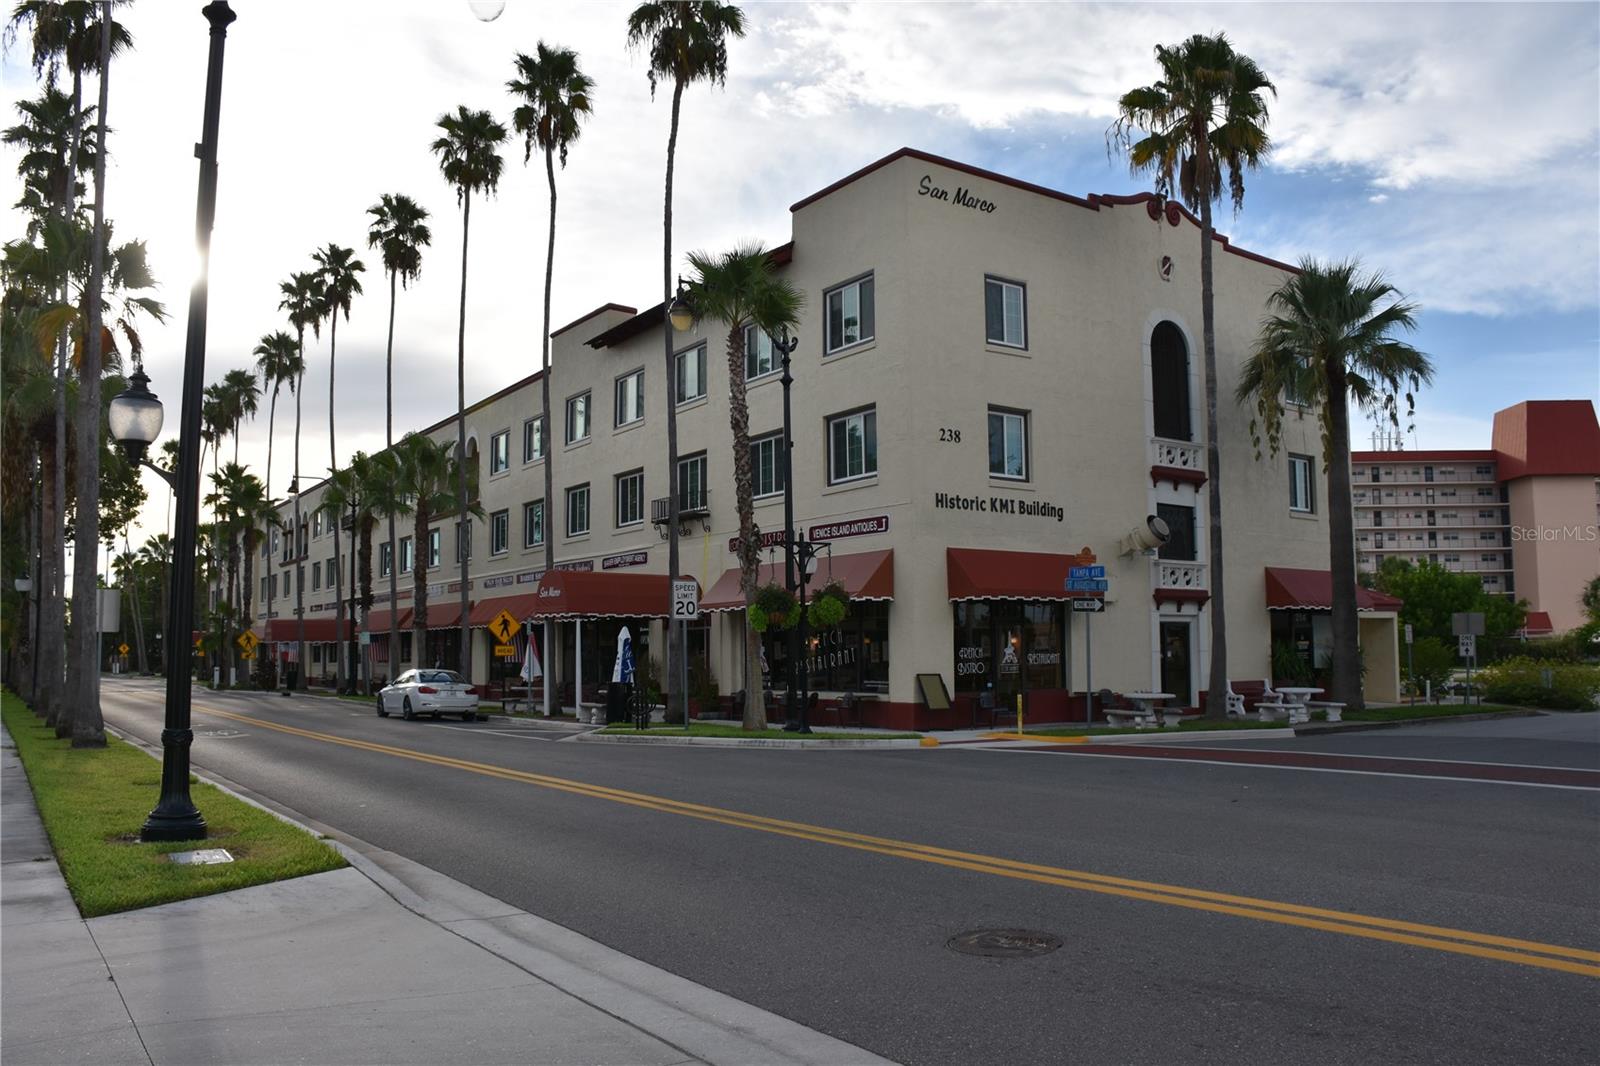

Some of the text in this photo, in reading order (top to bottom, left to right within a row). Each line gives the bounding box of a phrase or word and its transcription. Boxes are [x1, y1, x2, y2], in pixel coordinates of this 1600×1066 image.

[918, 175, 997, 213] San Marco
[939, 428, 961, 443] 238
[935, 492, 1063, 522] Historic KMI Building
[812, 522, 877, 540] VENICE ISLAND ANTIQUES
[1073, 567, 1102, 577] TAMPA AVE
[676, 601, 695, 615] 20
[959, 647, 984, 660] FRENCH
[957, 661, 985, 675] BISTRO
